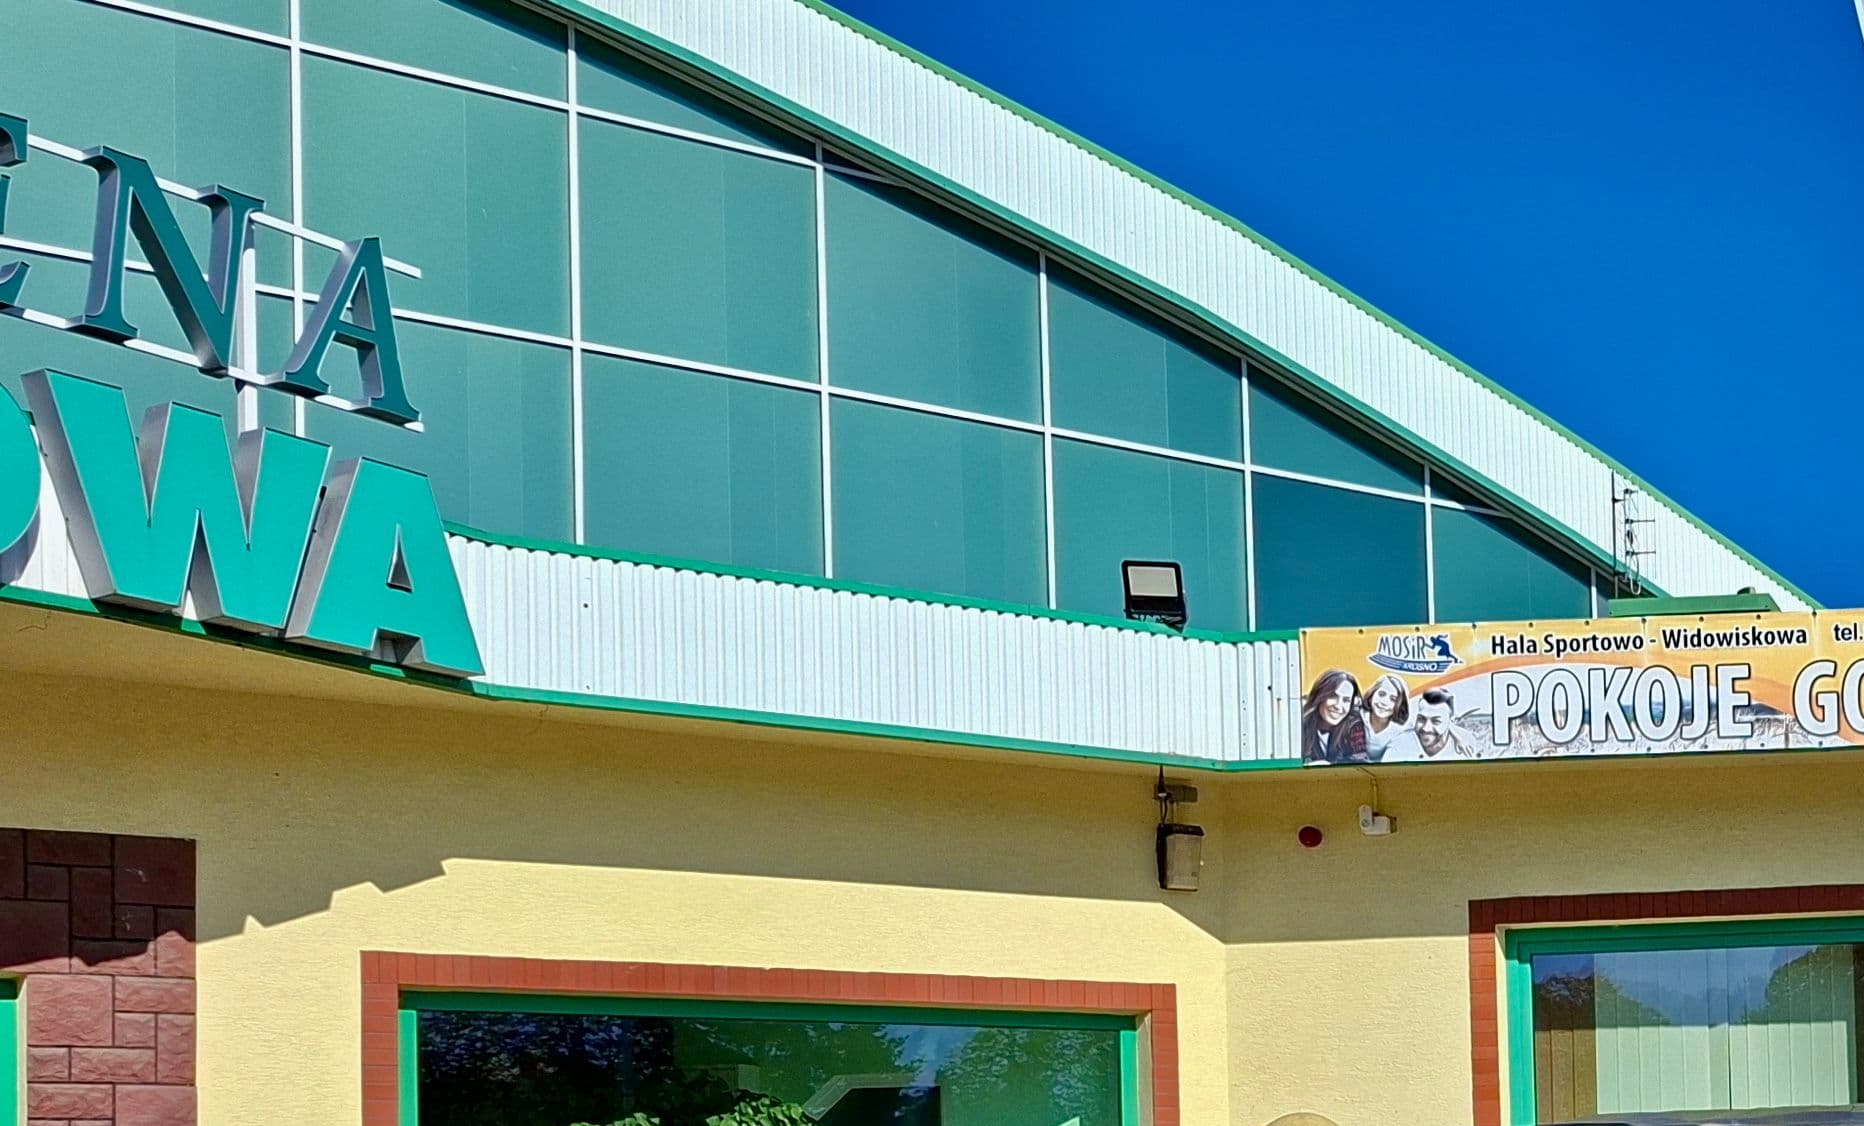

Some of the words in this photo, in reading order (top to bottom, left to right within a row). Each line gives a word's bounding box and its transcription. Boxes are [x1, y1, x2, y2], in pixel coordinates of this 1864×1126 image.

[0, 368, 486, 677] WA
[1491, 634, 1537, 655] Hala
[1543, 633, 1644, 658] Sportowo
[1662, 626, 1808, 649] Widowiskowa
[1491, 663, 1753, 746] POKOJE
